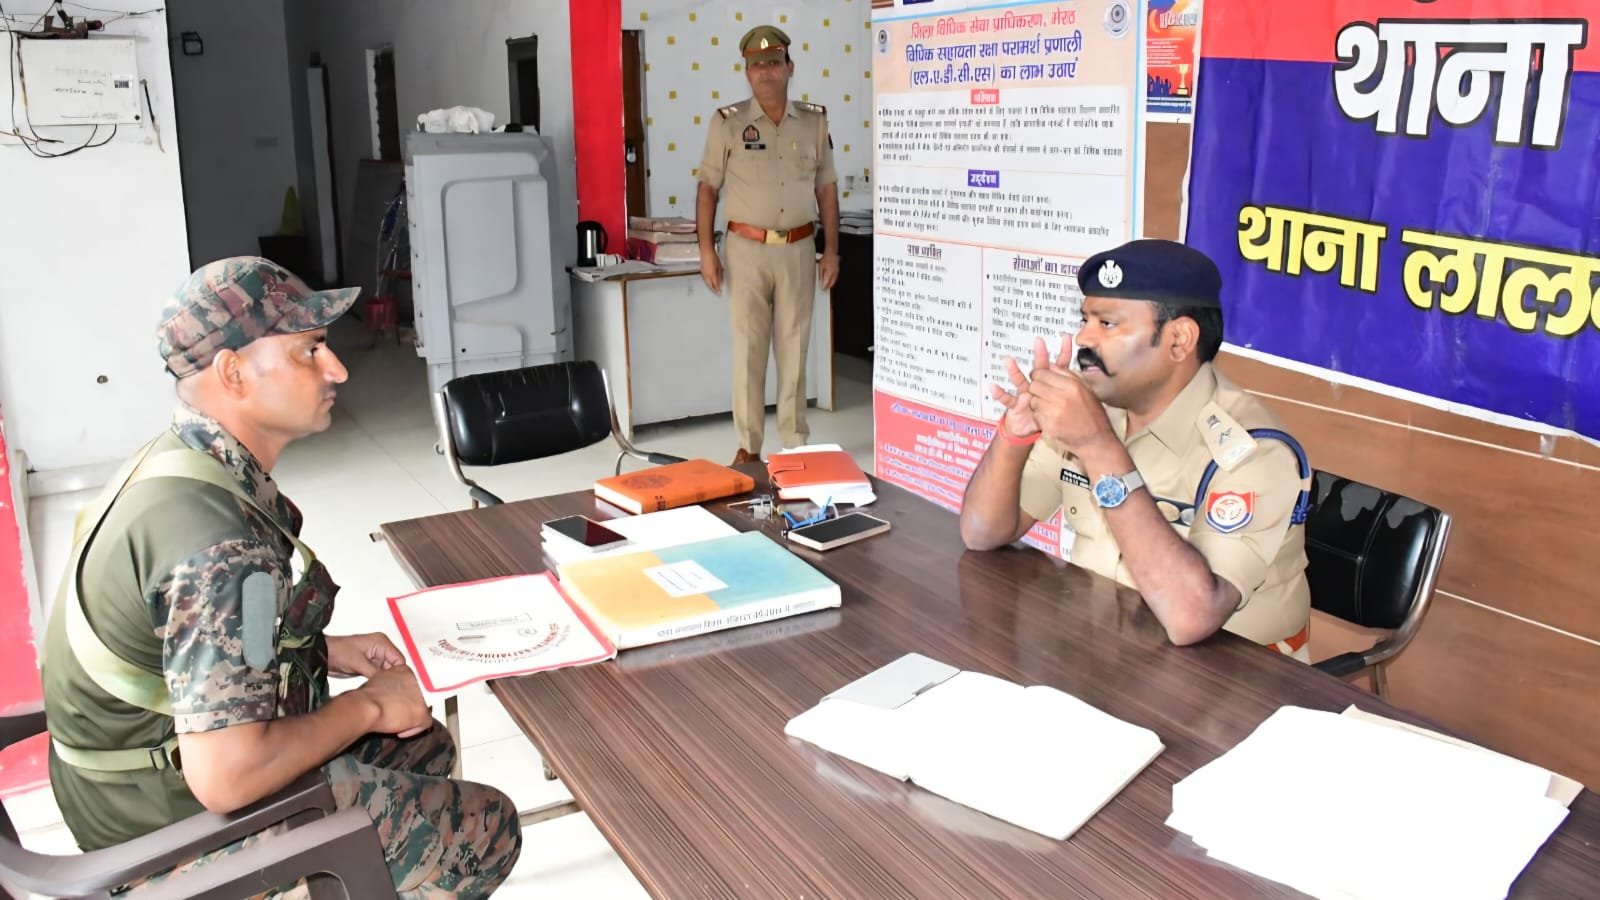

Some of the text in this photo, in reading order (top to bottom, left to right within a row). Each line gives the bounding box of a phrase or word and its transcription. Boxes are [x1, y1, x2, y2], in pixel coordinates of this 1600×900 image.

[979, 42, 998, 58] रक्षा
[1001, 33, 1041, 56] परामर्श
[1044, 29, 1082, 56] प्रणाली
[1000, 65, 1016, 80] का
[1019, 63, 1044, 80] लाभ
[1335, 19, 1587, 149] थाना
[1237, 204, 1600, 337] थाना लाल
